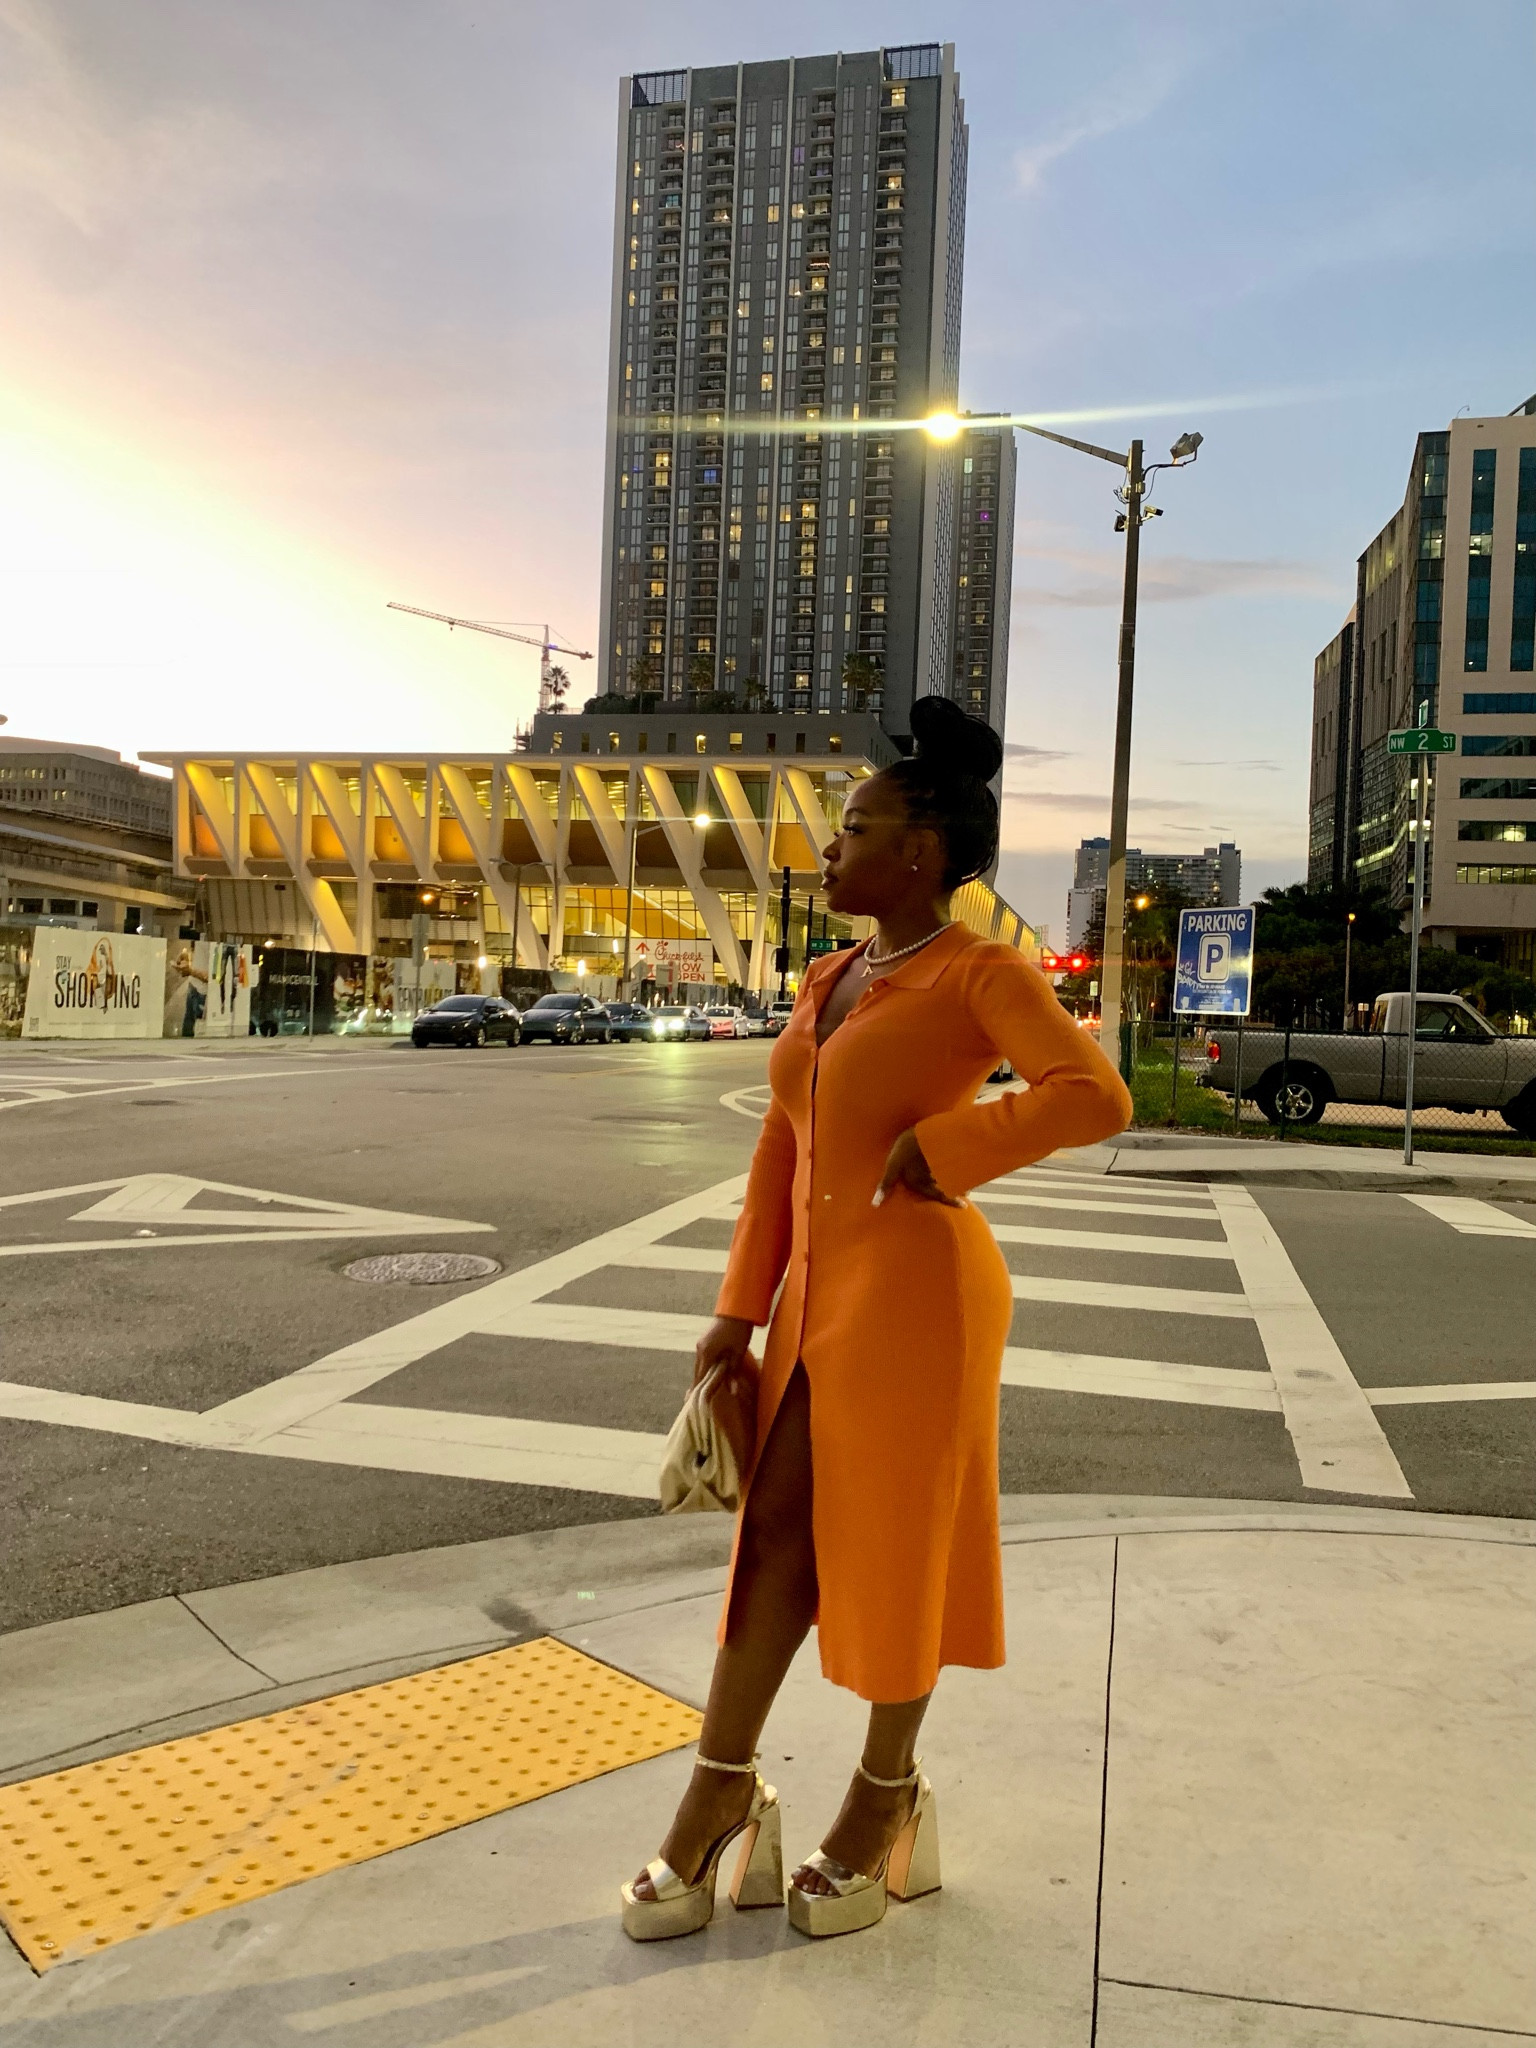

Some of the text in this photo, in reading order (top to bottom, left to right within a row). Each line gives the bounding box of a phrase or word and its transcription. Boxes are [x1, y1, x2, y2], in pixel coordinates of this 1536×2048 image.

[1391, 733, 1454, 750] NW 2 ST
[1188, 914, 1247, 932] PARKING
[56, 956, 72, 970] STAY
[1206, 944, 1224, 973] P
[861, 965, 873, 978] A
[54, 971, 141, 1009] SHOPPING
